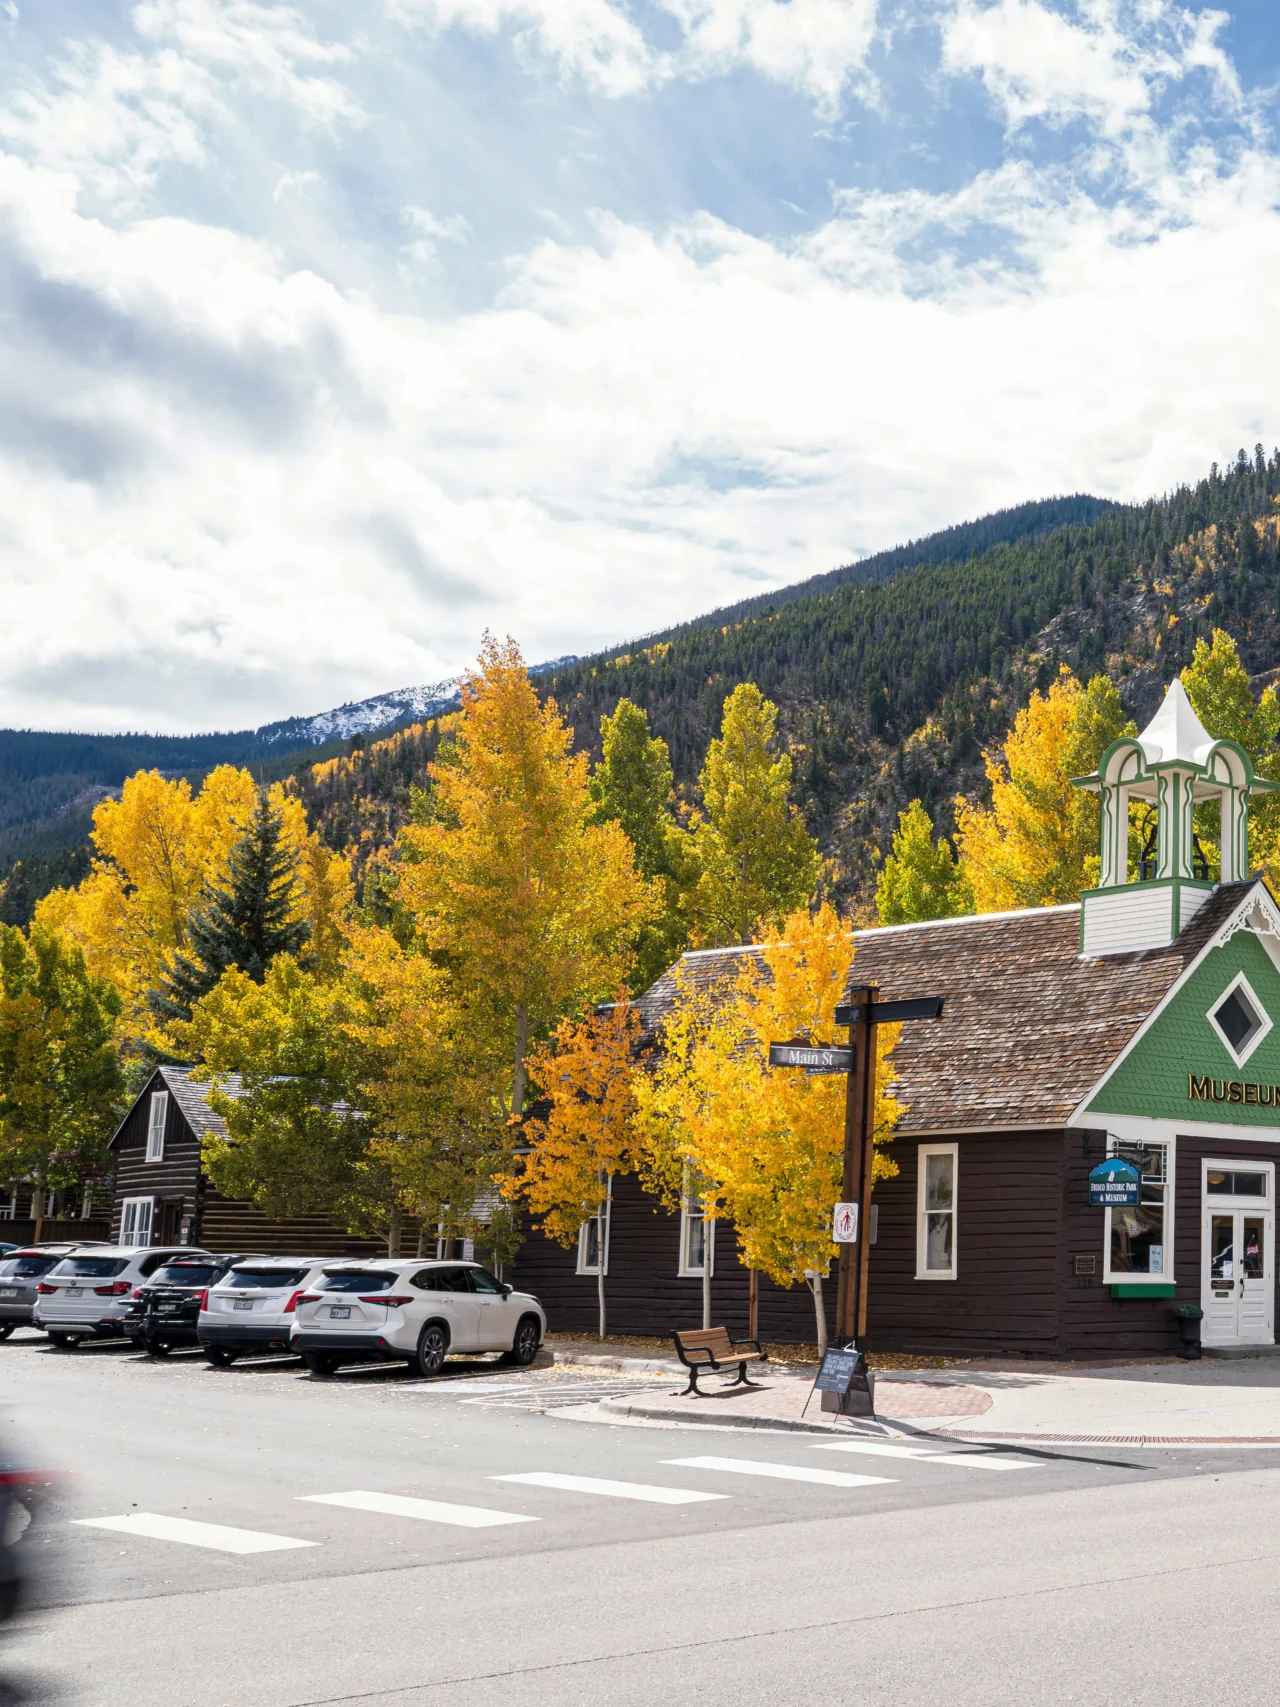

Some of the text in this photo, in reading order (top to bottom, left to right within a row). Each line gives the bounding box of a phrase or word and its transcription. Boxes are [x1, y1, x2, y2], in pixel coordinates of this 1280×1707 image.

[788, 1050, 834, 1066] Main St
[1091, 1183, 1137, 1192] FRISCO HISTORIC PARK
[1100, 1194, 1127, 1202] & MUSEUM
